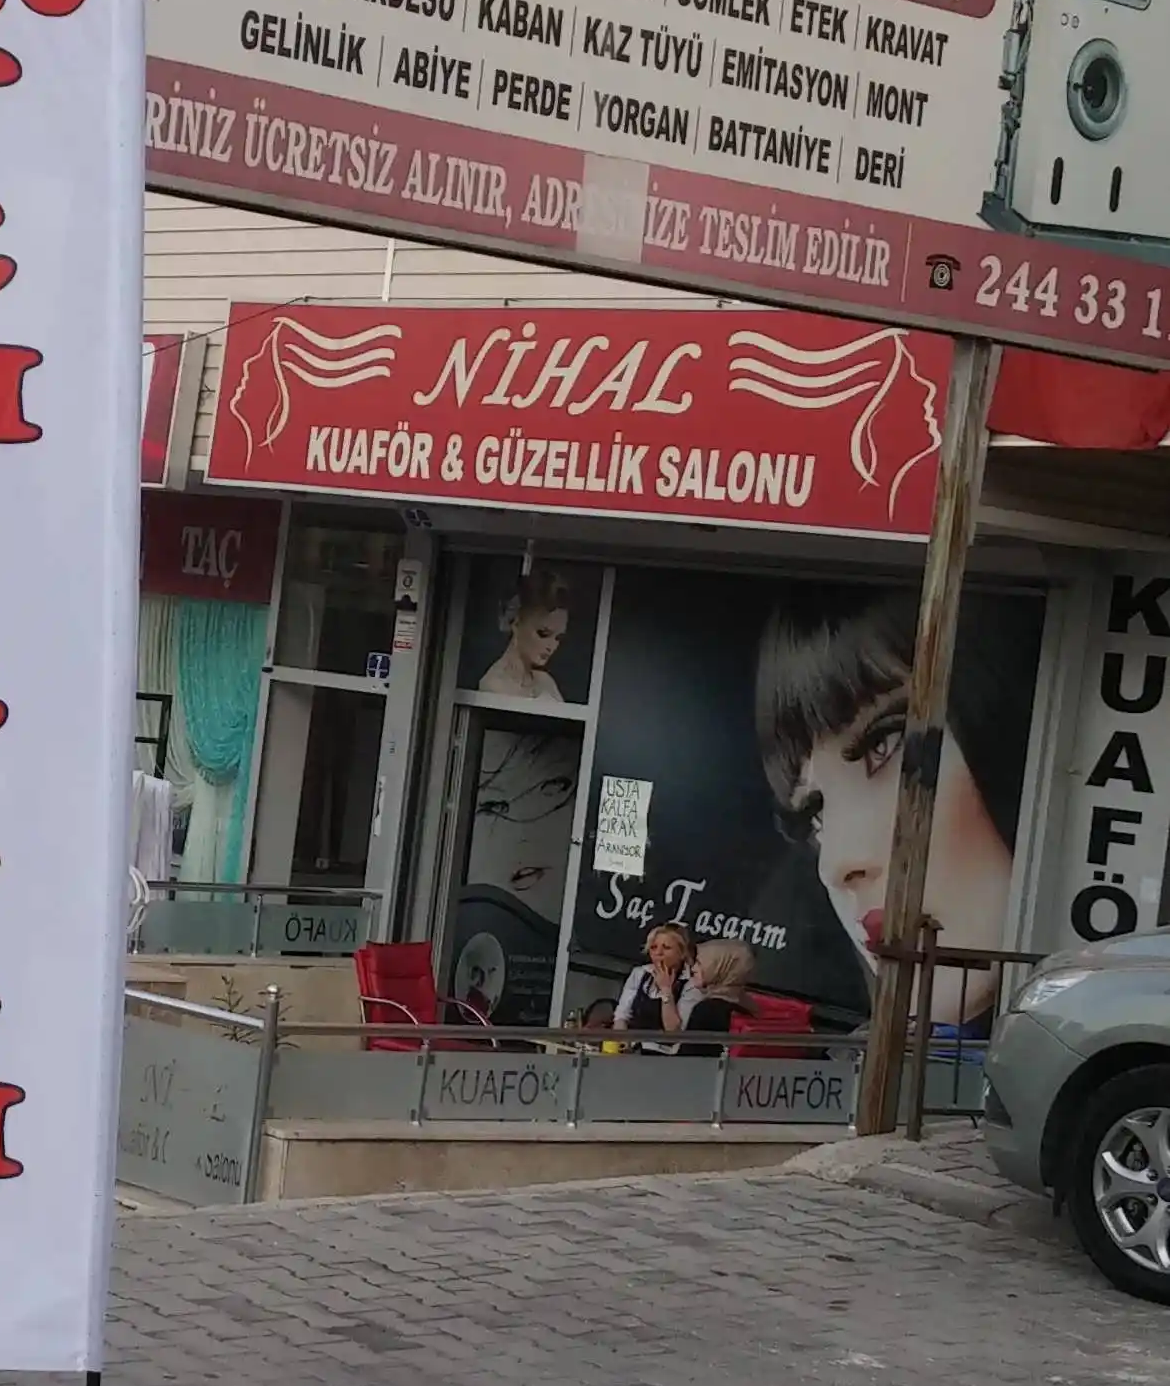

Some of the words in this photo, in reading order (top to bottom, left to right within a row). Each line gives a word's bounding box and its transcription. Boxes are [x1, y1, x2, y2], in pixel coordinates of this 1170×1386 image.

[583, 15, 630, 63] KAZ
[641, 27, 704, 78] TÜYÜ
[721, 46, 849, 111] EMİTASYON
[866, 81, 928, 128] MONT
[865, 14, 949, 68] KRAVAT
[241, 9, 366, 75] GELİNLİK
[393, 43, 472, 100] ABİYE
[492, 68, 572, 121] PERDE
[593, 90, 689, 146] YORGAN
[707, 116, 831, 176] BATTANİYE
[855, 146, 905, 189] DERİ
[244, 97, 395, 196] ÜCRETSİZ
[699, 204, 799, 271] TESLİM
[803, 219, 890, 287] EDİLİR
[975, 255, 1059, 317] 244
[1074, 274, 1127, 329] 33
[1141, 287, 1170, 342] 1
[413, 321, 704, 415] NİHAL
[306, 425, 431, 482] KUAFÖR
[441, 439, 464, 481] &
[475, 427, 650, 497] GÜZELLİK
[656, 446, 816, 508] SALONU
[181, 525, 243, 589] TAÇ
[600, 797, 638, 819] KALFA
[606, 779, 640, 800] USTA
[596, 872, 655, 928] Saç
[737, 1070, 842, 1110] KUAFÖR
